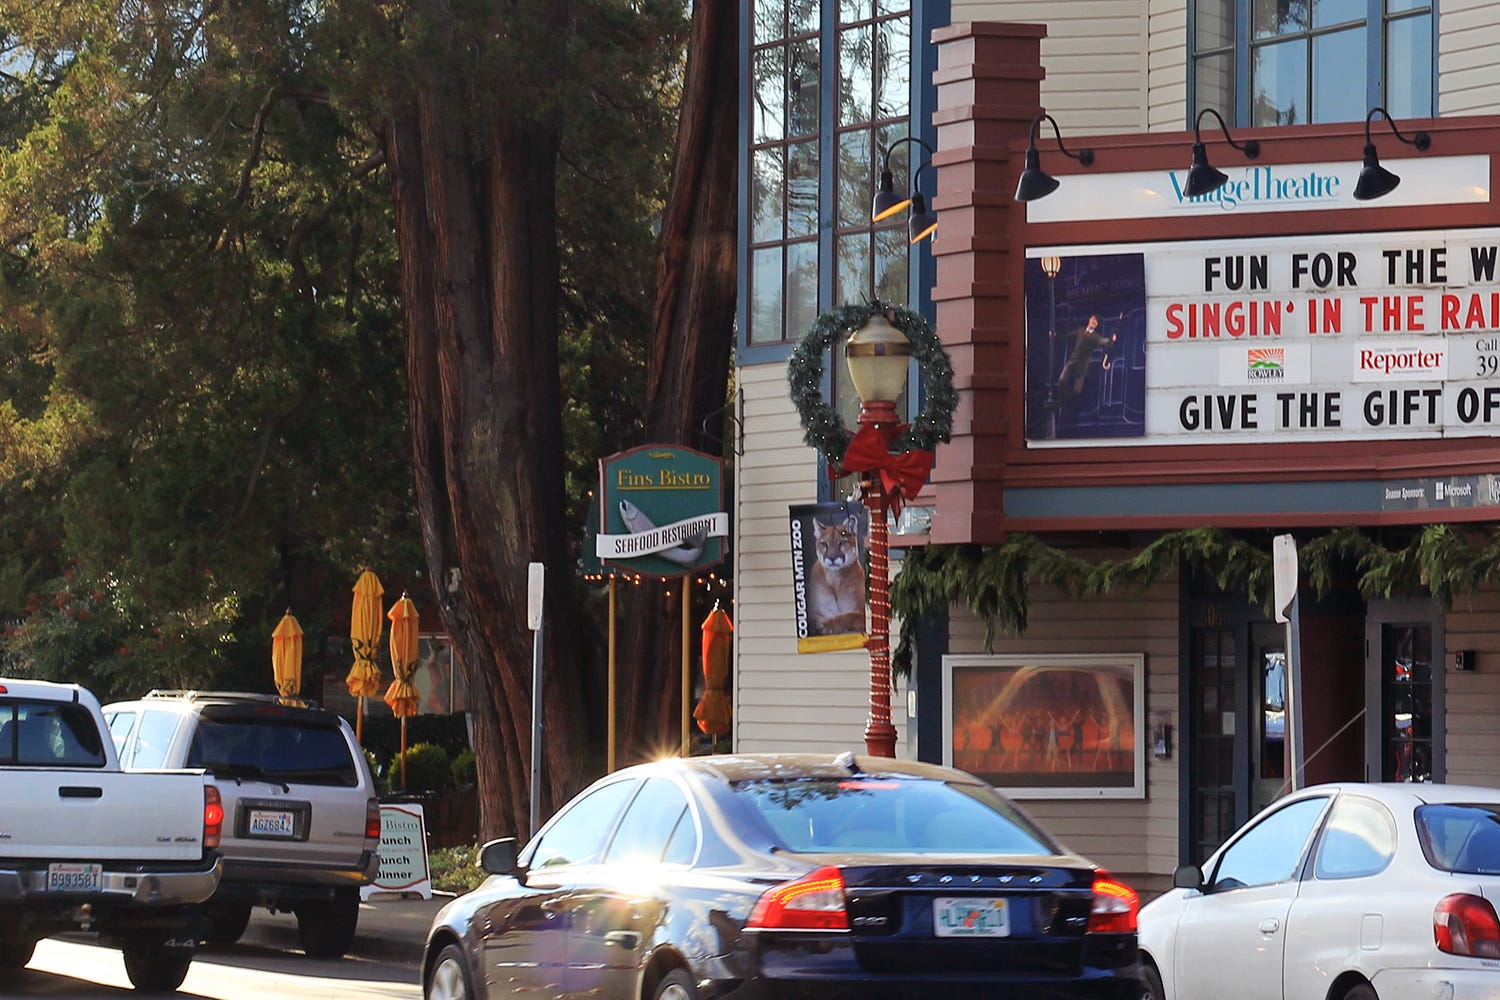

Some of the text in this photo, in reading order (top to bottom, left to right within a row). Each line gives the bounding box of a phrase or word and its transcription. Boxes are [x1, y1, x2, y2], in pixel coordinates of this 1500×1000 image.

[1204, 255, 1269, 292] FUN
[1291, 252, 1358, 288] FOR
[1382, 248, 1448, 285] THE
[1166, 301, 1295, 339] SINGIN'
[1308, 299, 1342, 334] IN
[1360, 294, 1425, 332] THE
[1475, 339, 1499, 352] Call
[1360, 349, 1444, 374] Reporter
[1179, 394, 1258, 431] GIVE
[1277, 392, 1341, 428] THE
[1364, 388, 1442, 426] GIFT
[1457, 386, 1500, 424] OF
[618, 469, 710, 486] Fins Bistro
[1444, 482, 1472, 497] Microsoft
[615, 531, 659, 554] SEAFOOD
[792, 519, 808, 638] COUGAR MTN ZOO
[386, 820, 418, 829] Bistro
[380, 856, 410, 864] unch
